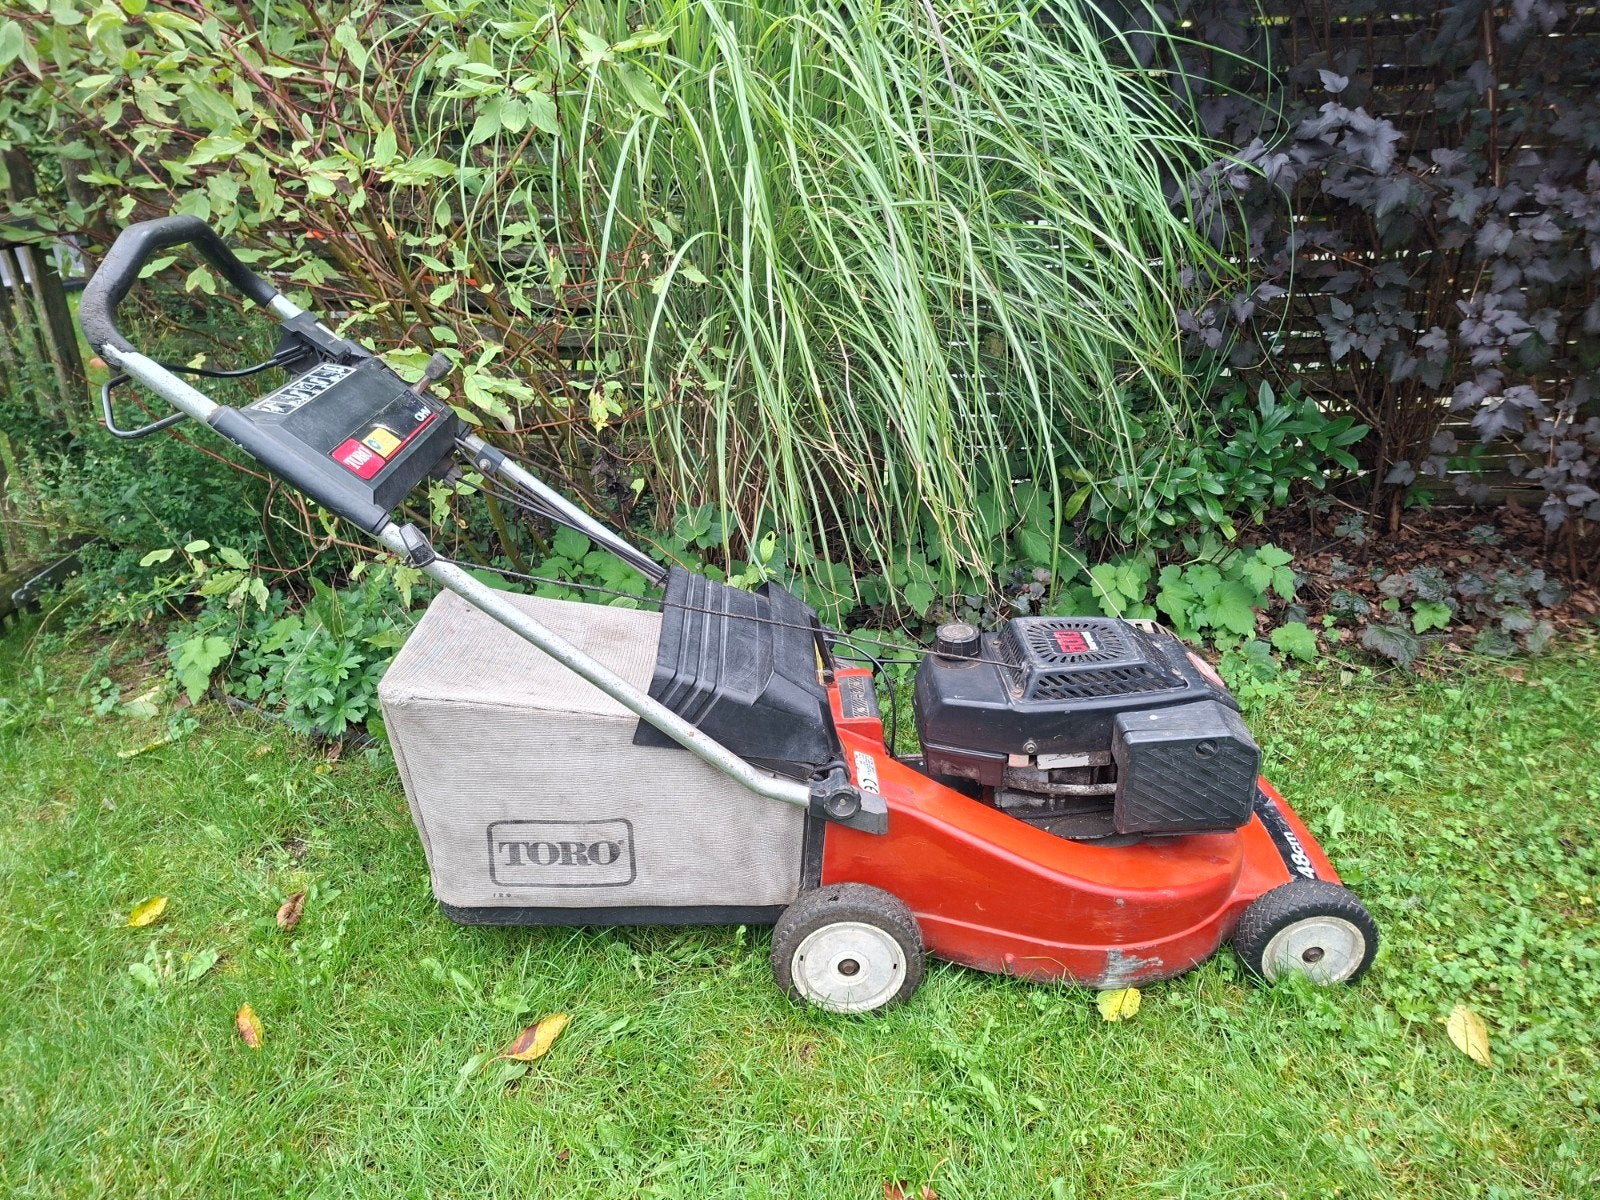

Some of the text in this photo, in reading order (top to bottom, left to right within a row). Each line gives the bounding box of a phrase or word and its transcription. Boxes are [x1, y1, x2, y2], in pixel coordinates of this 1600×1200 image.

[343, 446, 374, 470] TORO
[498, 840, 622, 867] TORO
[1283, 831, 1315, 880] 48cm
